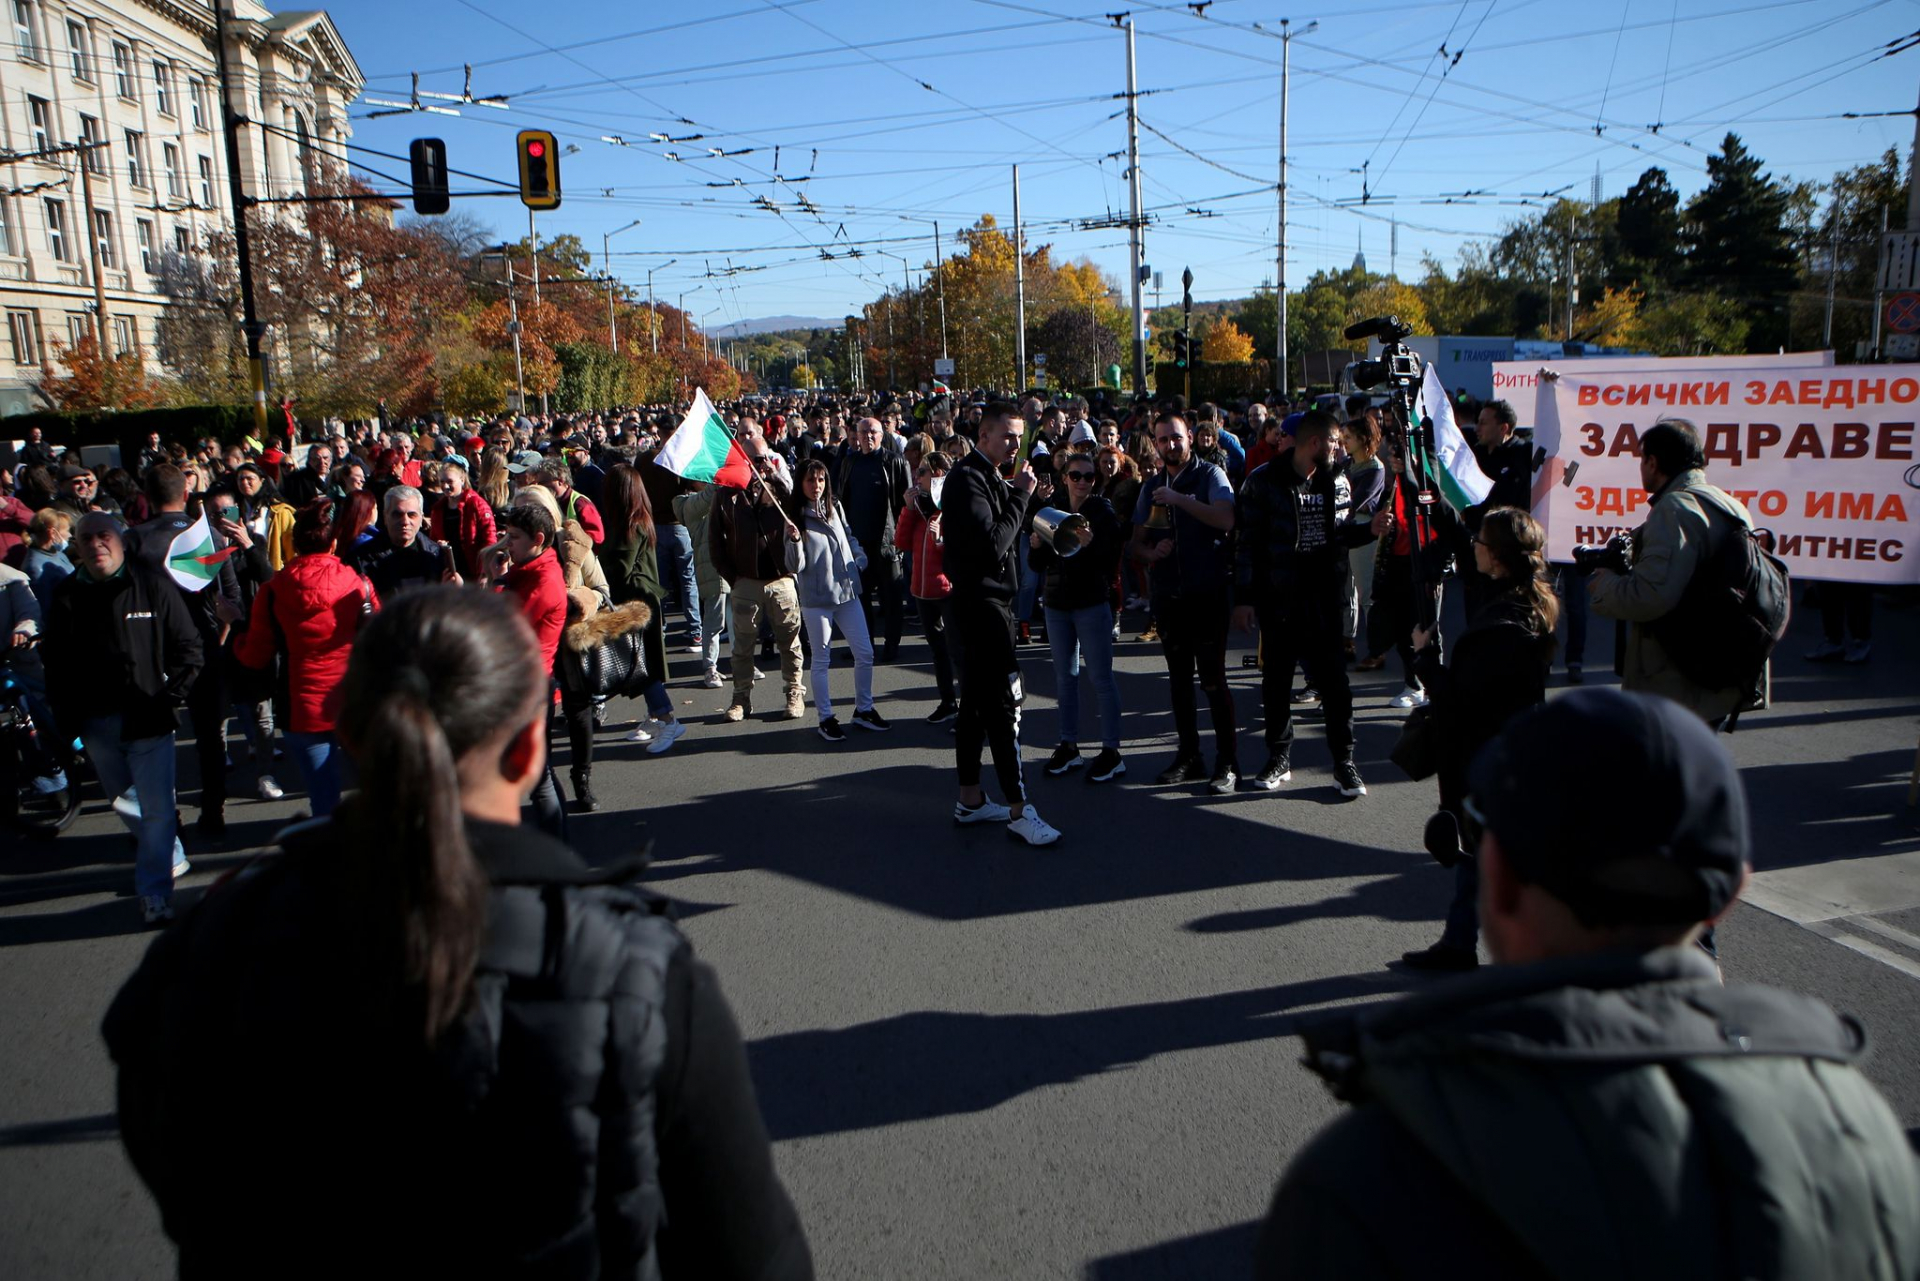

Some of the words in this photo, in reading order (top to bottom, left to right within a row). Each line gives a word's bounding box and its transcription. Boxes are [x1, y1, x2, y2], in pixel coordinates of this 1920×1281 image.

[1577, 381, 1730, 406] ВСИЧКИ
[1744, 377, 1920, 410] ЗАЕДНО
[1704, 421, 1915, 467] ДРАВЕ
[1298, 492, 1325, 506] 1978
[1804, 491, 1908, 522] ИМА
